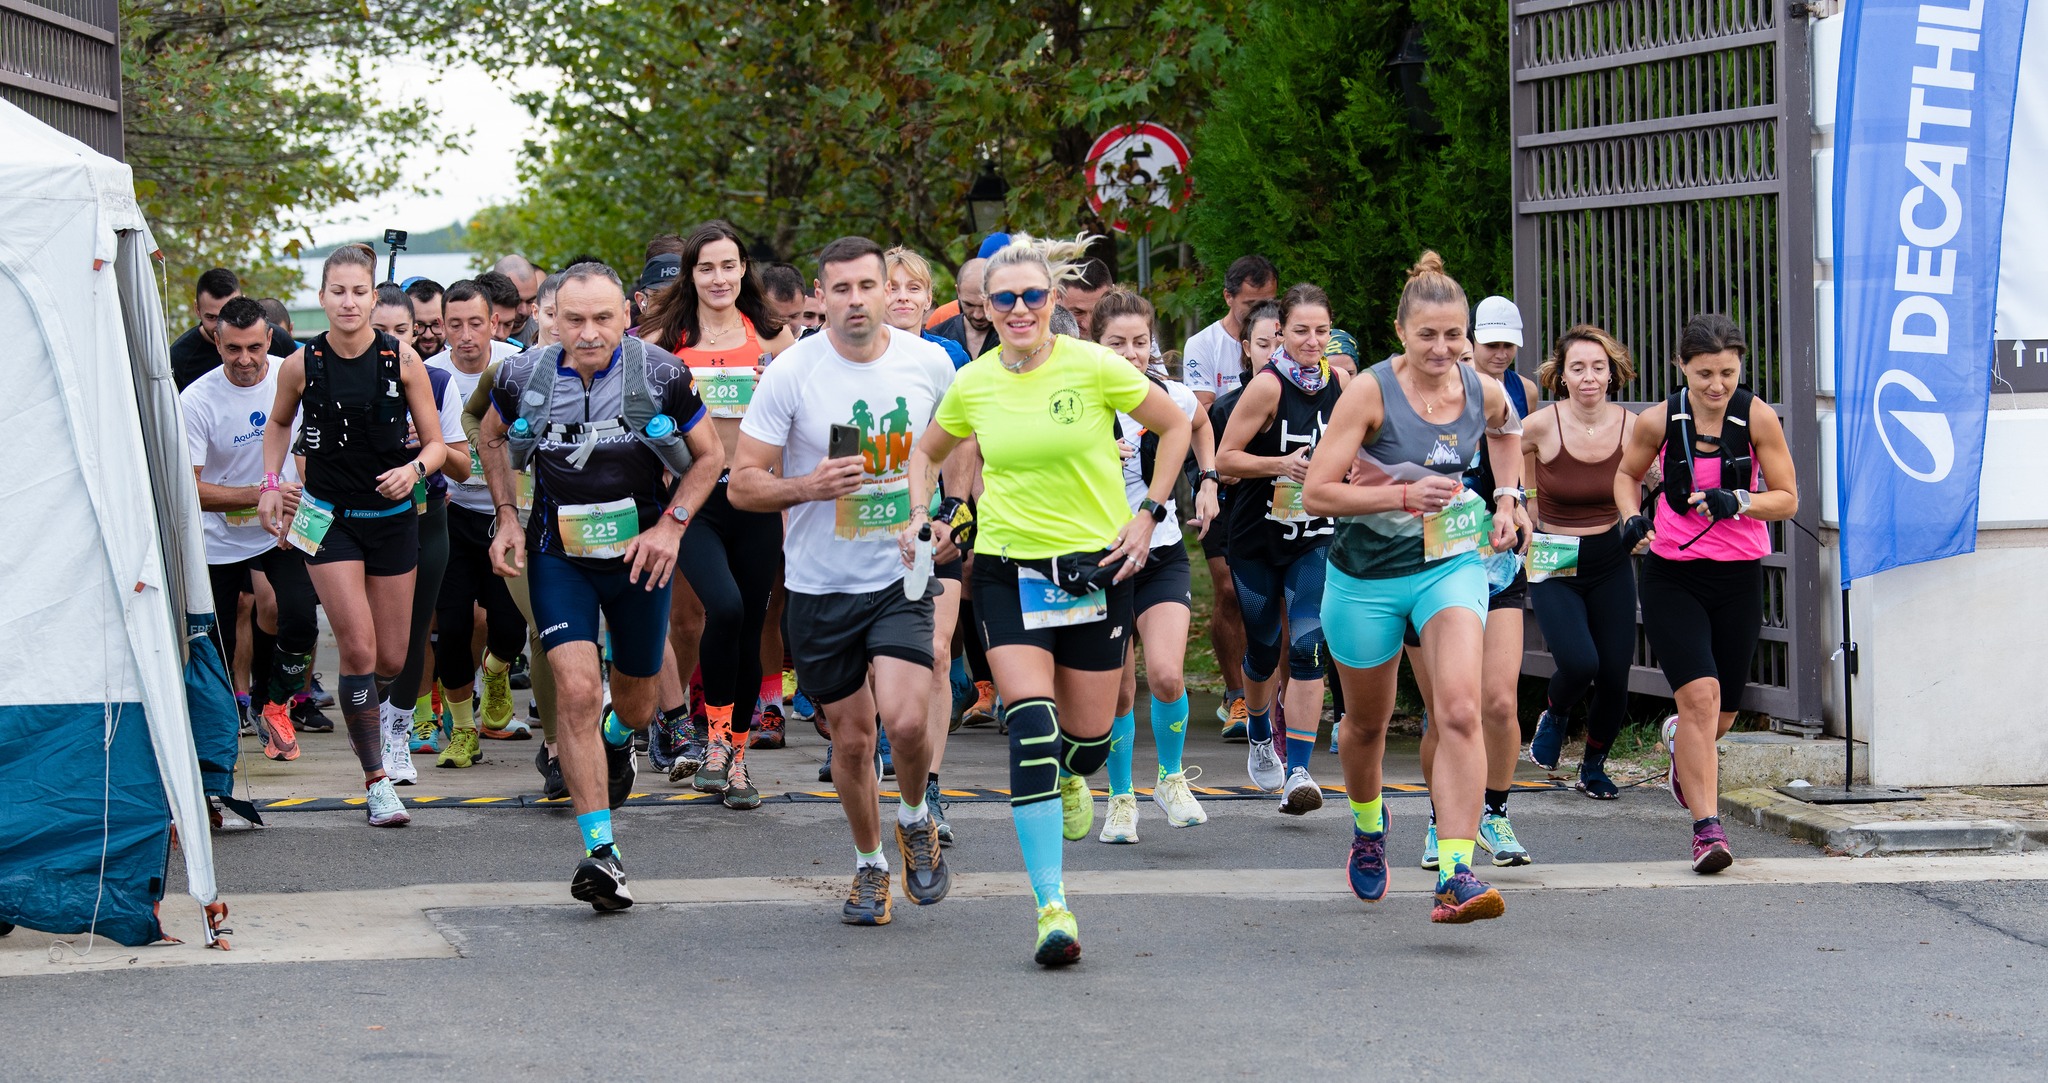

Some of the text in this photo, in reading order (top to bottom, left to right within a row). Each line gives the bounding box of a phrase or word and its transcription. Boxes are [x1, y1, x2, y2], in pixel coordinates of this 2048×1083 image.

[706, 384, 739, 399] 208
[858, 502, 897, 520] 226
[582, 521, 618, 539] 225
[1445, 511, 1477, 533] 201
[1533, 550, 1559, 565] 234
